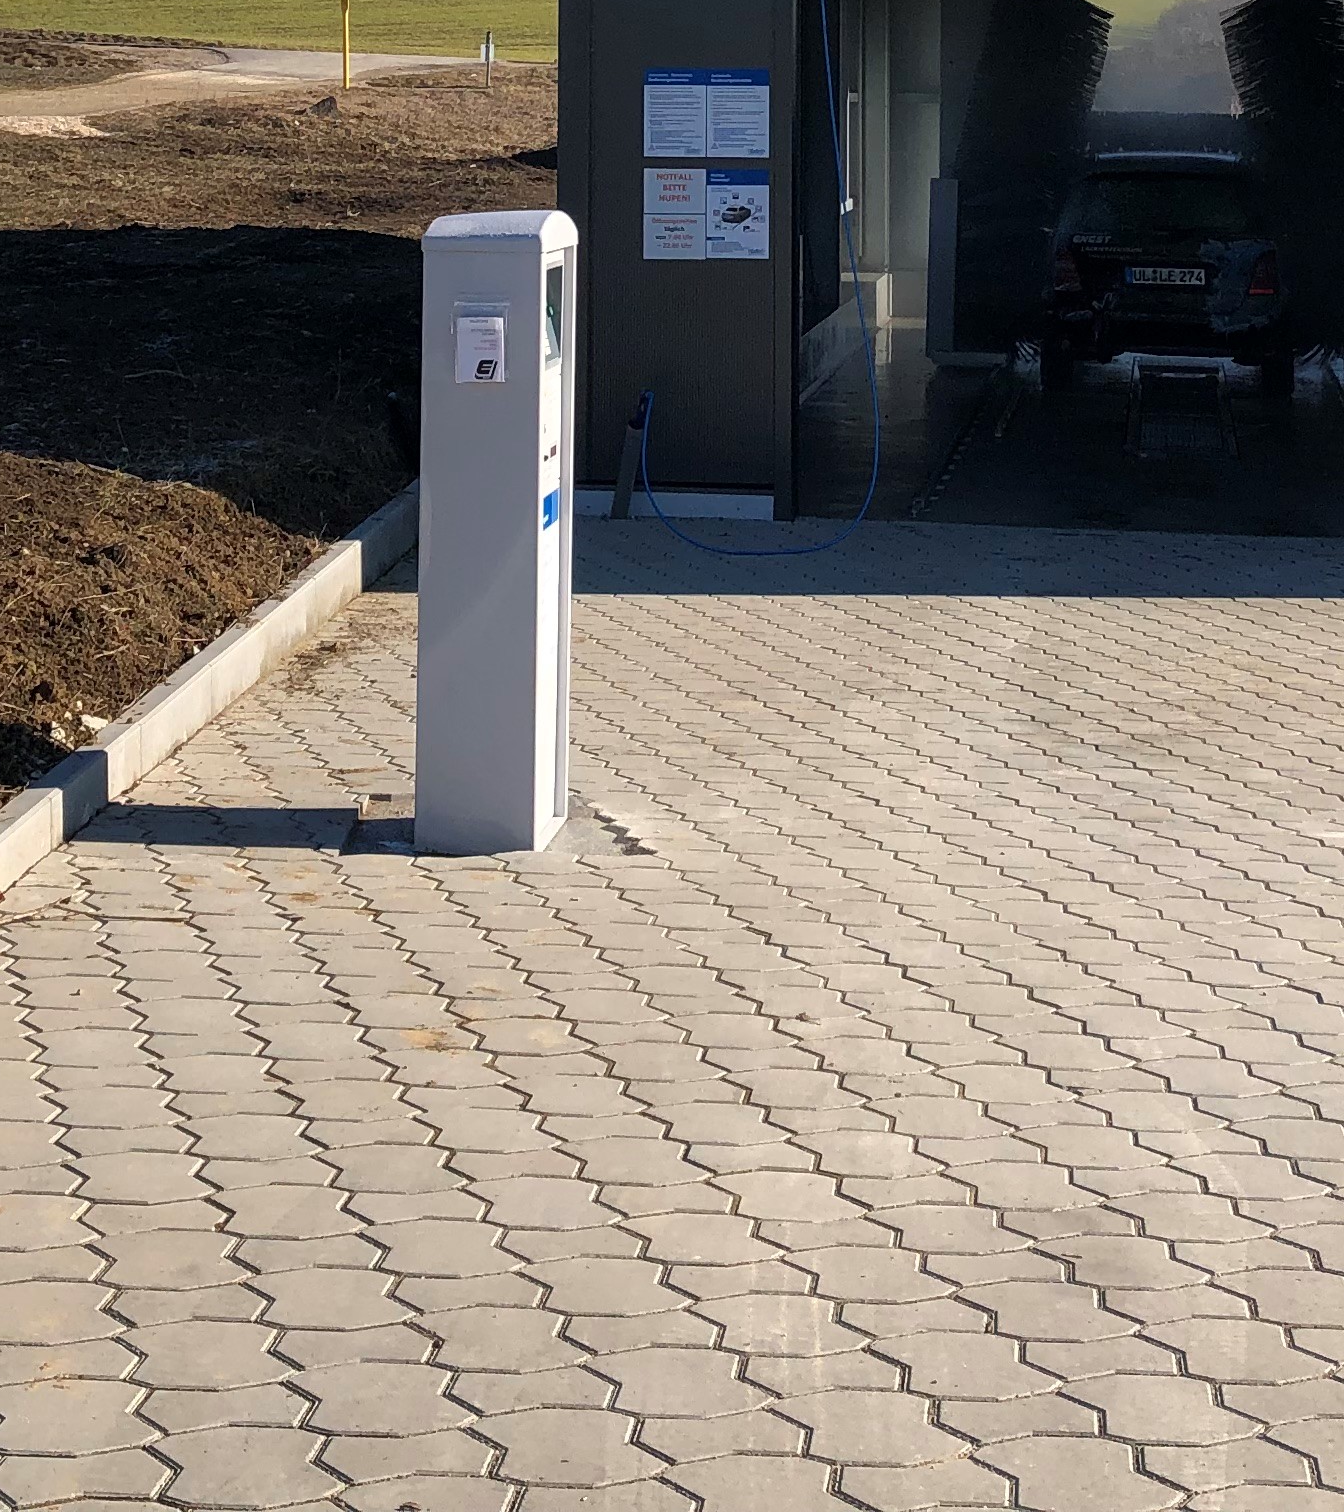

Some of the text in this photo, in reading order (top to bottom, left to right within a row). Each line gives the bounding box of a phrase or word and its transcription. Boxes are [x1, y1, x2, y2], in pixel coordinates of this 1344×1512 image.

[656, 173, 693, 181] NOTFALL
[662, 184, 687, 192] BITTE
[1133, 269, 1203, 284] UL LE 274
